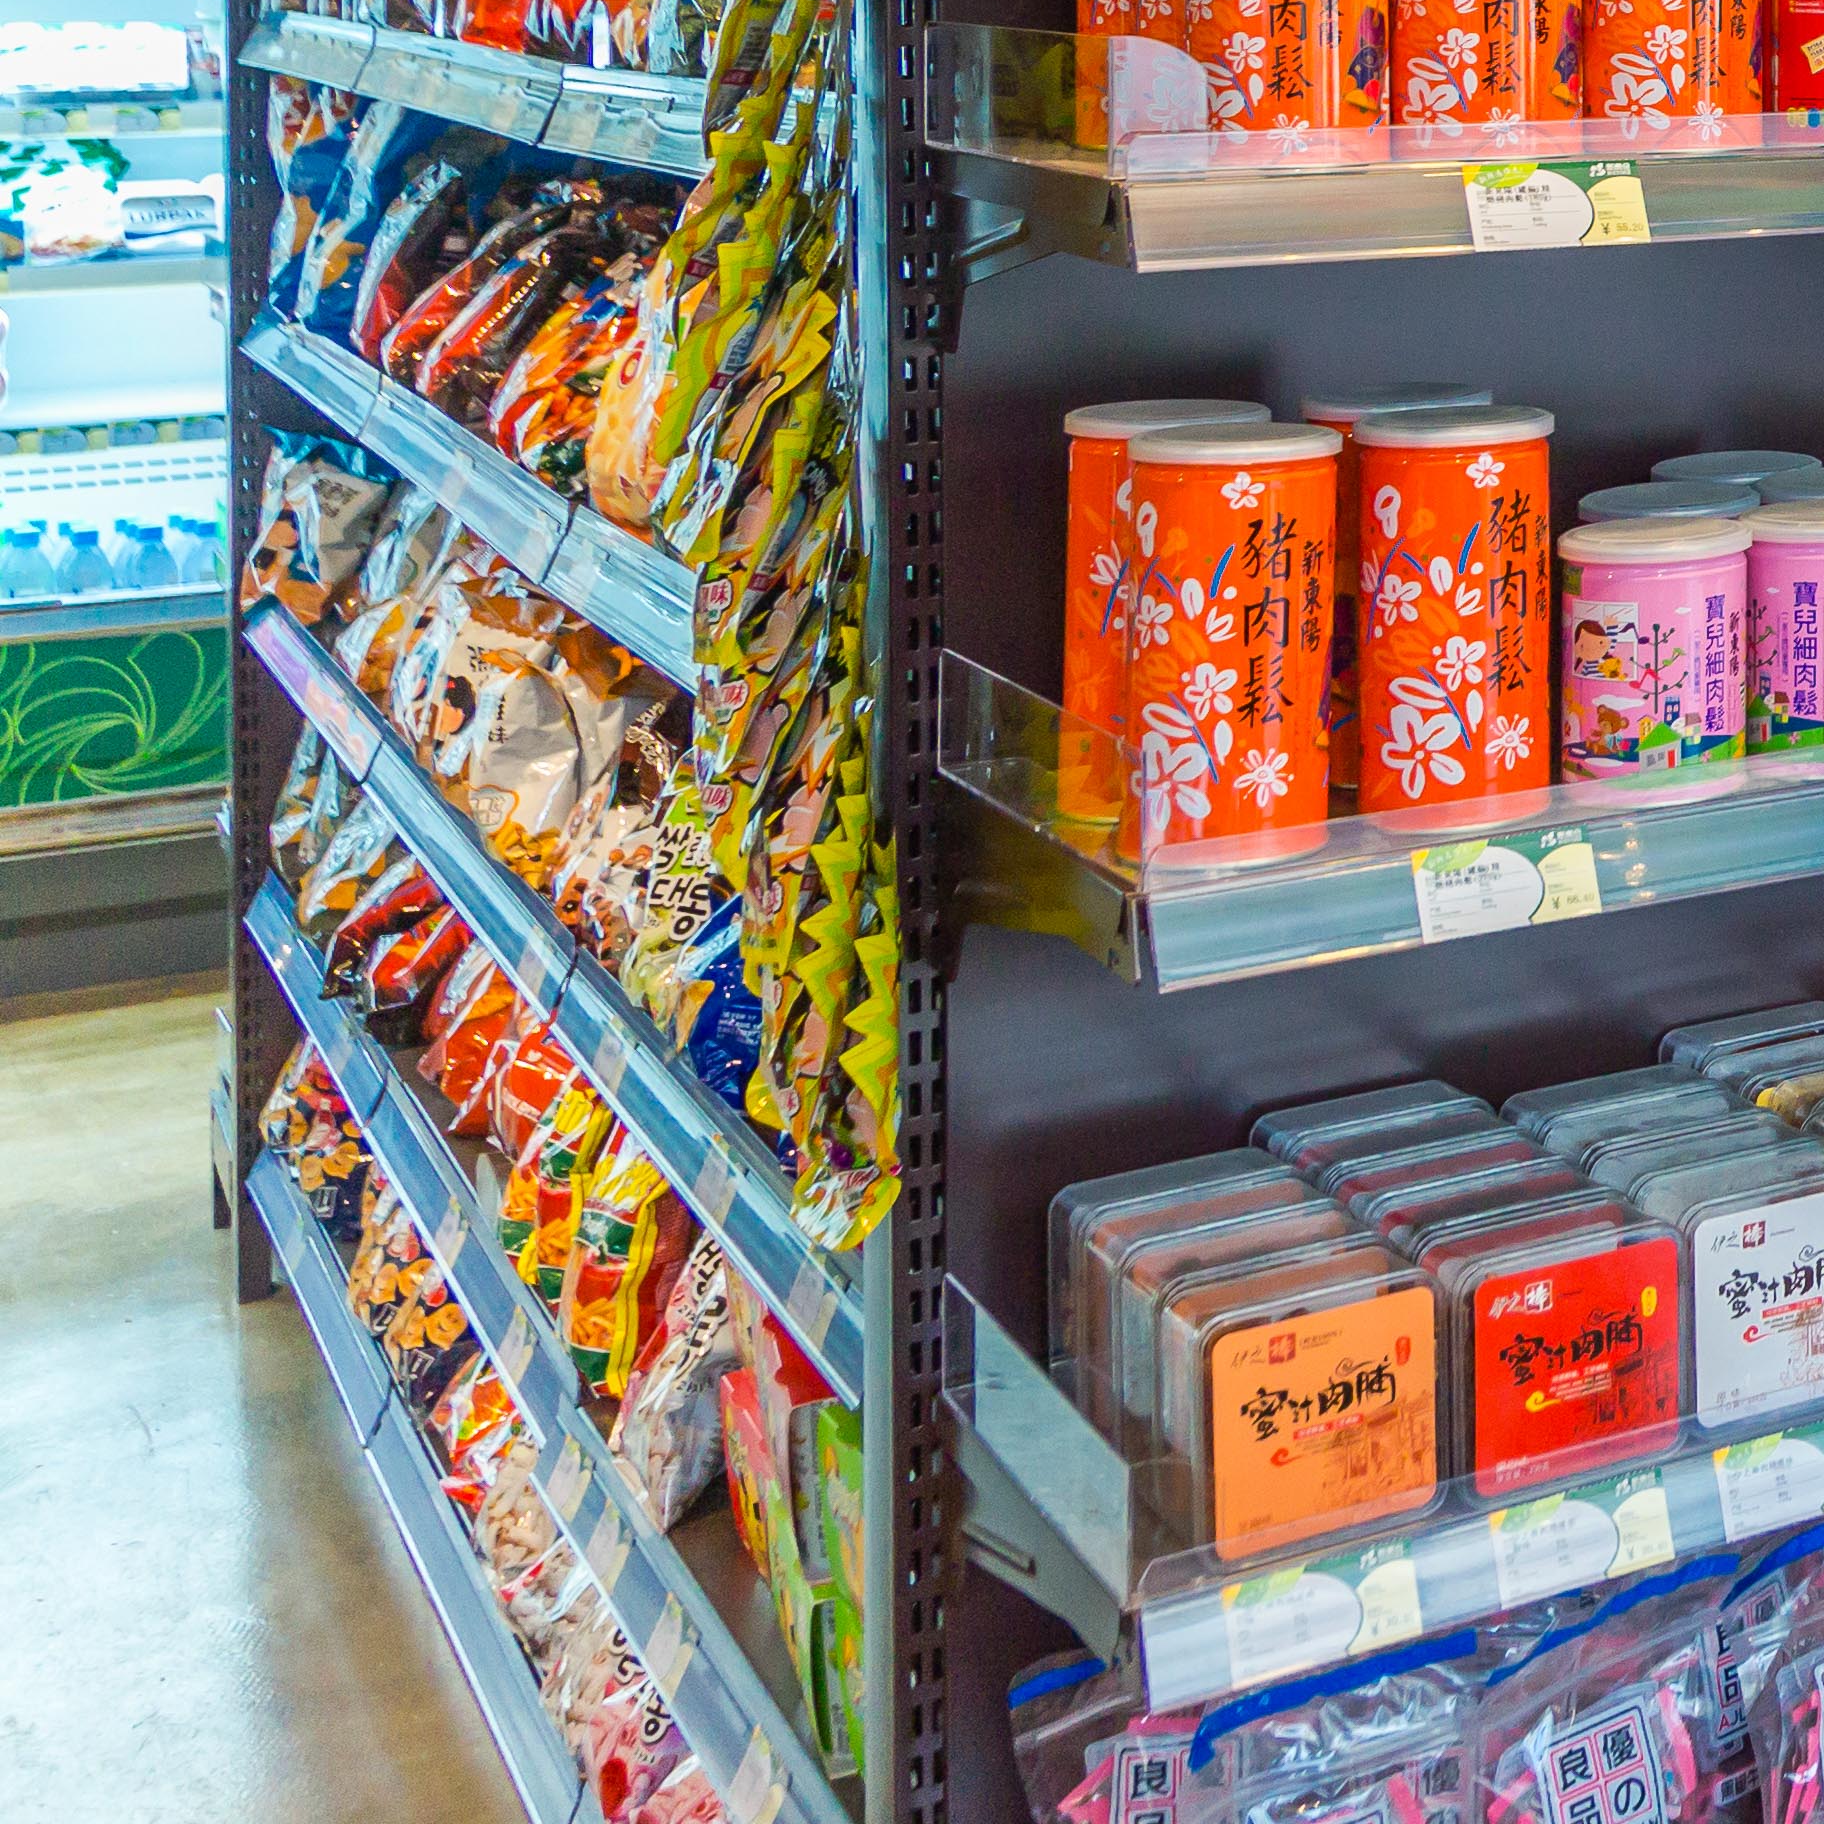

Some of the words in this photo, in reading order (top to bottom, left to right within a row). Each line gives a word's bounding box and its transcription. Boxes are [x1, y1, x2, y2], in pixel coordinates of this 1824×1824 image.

[1237, 512, 1296, 728] 豬肉鬆
[1300, 539, 1324, 653] 新東陽
[1485, 488, 1532, 696] 豬肉鬆
[1793, 580, 1818, 716] 寶兒細肉鬆
[1705, 594, 1726, 732] 寶兒細肉鬆
[1240, 1355, 1396, 1442] 蜜汁肉脯
[1500, 1308, 1643, 1386] 蜜汁肉脯
